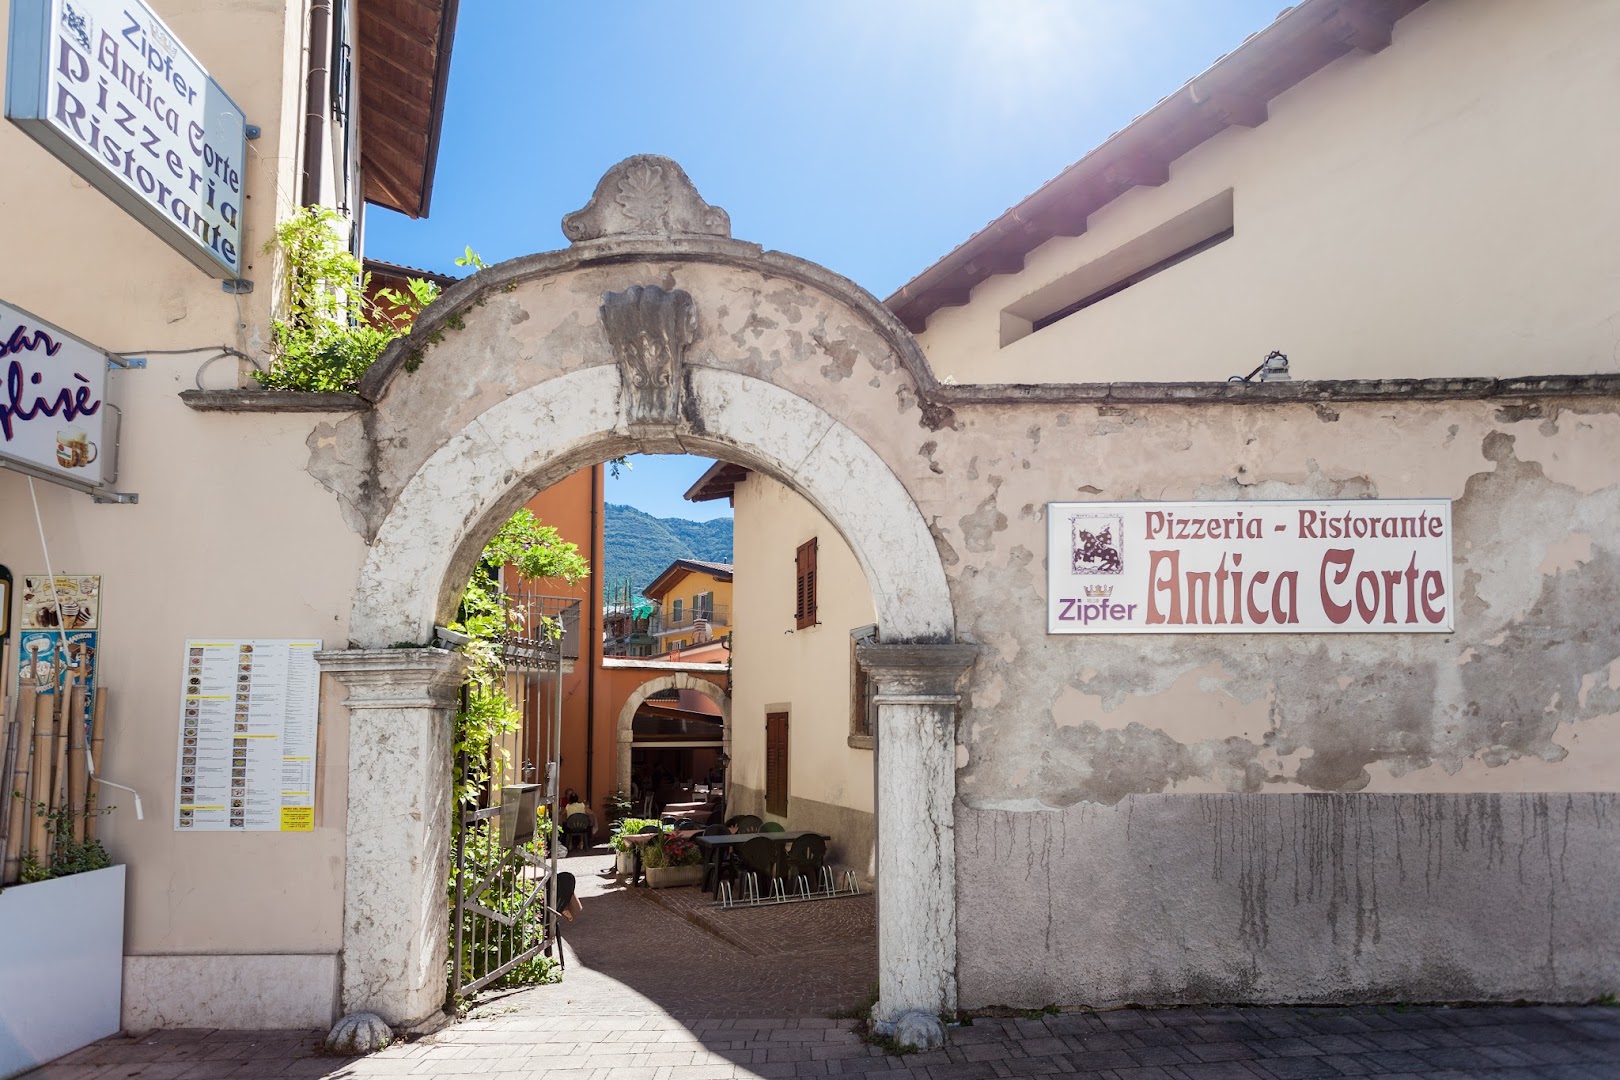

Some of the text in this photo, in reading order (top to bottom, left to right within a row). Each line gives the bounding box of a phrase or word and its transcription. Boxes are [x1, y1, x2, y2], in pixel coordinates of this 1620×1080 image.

[122, 10, 197, 106] Zipfer
[57, 35, 237, 230] Pizzeria
[98, 28, 239, 194] Antica Corte
[55, 82, 236, 264] Ristorante
[1145, 511, 1263, 540] Pizzeria
[1298, 509, 1443, 540] Ristorante
[1058, 598, 1137, 625] Zipfer
[1145, 548, 1446, 625] Antica Corte
